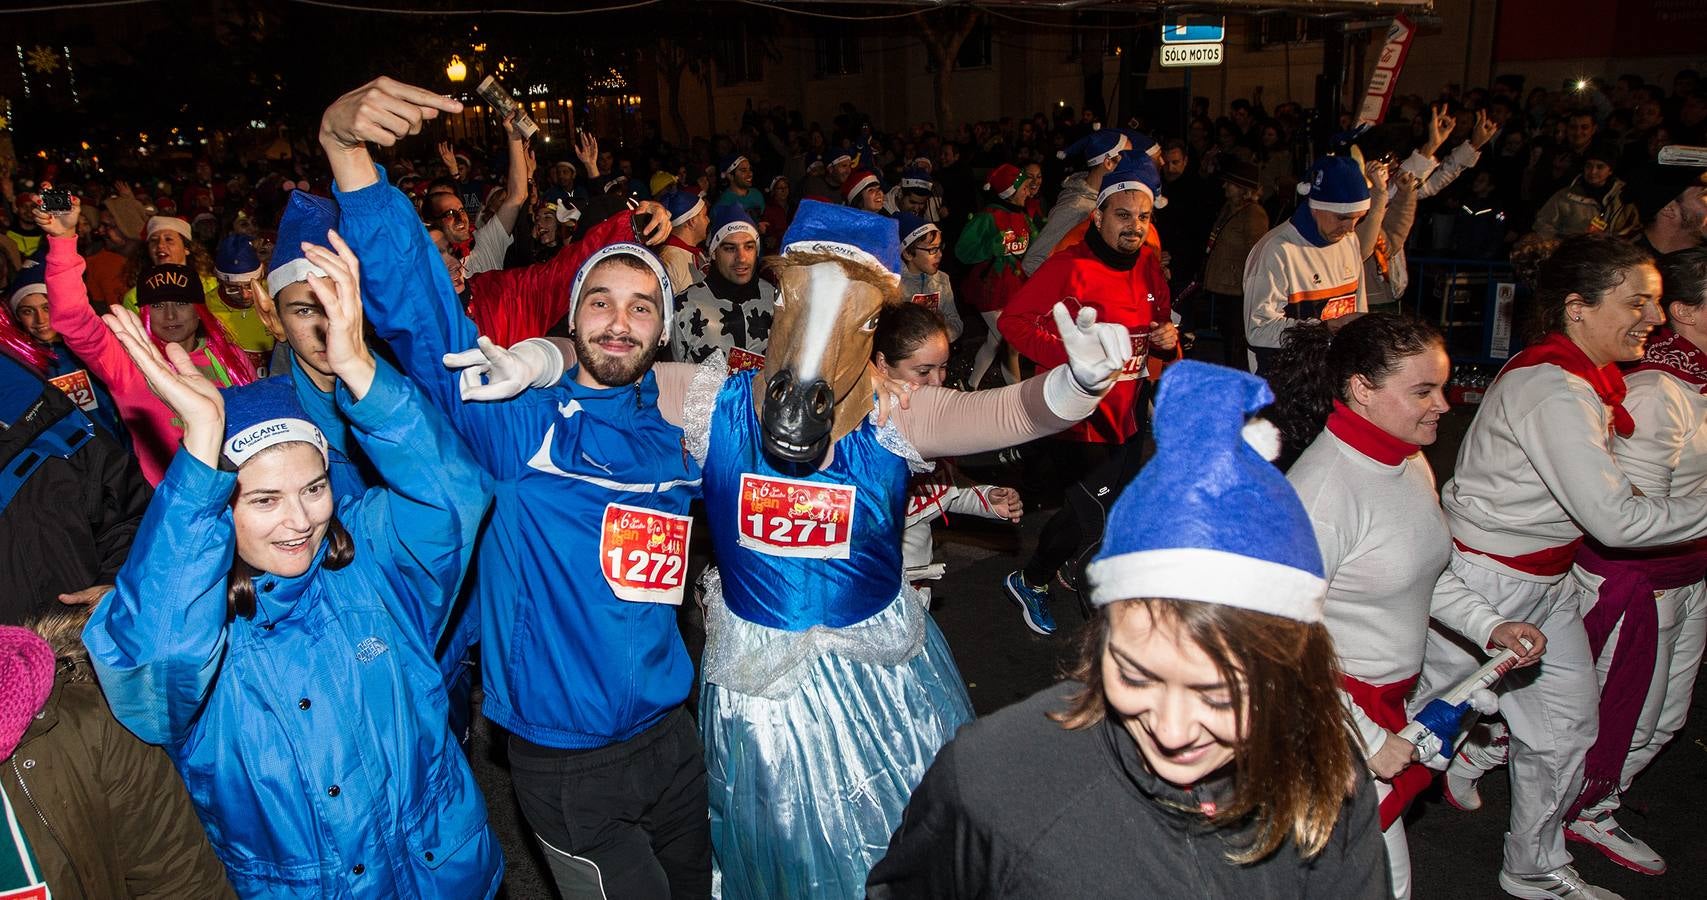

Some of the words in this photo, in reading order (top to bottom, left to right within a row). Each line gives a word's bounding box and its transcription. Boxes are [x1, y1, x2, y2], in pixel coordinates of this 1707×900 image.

[1165, 48, 1187, 61] SÓLO
[1189, 48, 1219, 60] MOTOS
[146, 271, 188, 289] TRND
[742, 513, 837, 543] 1271
[607, 547, 682, 585] 1272
